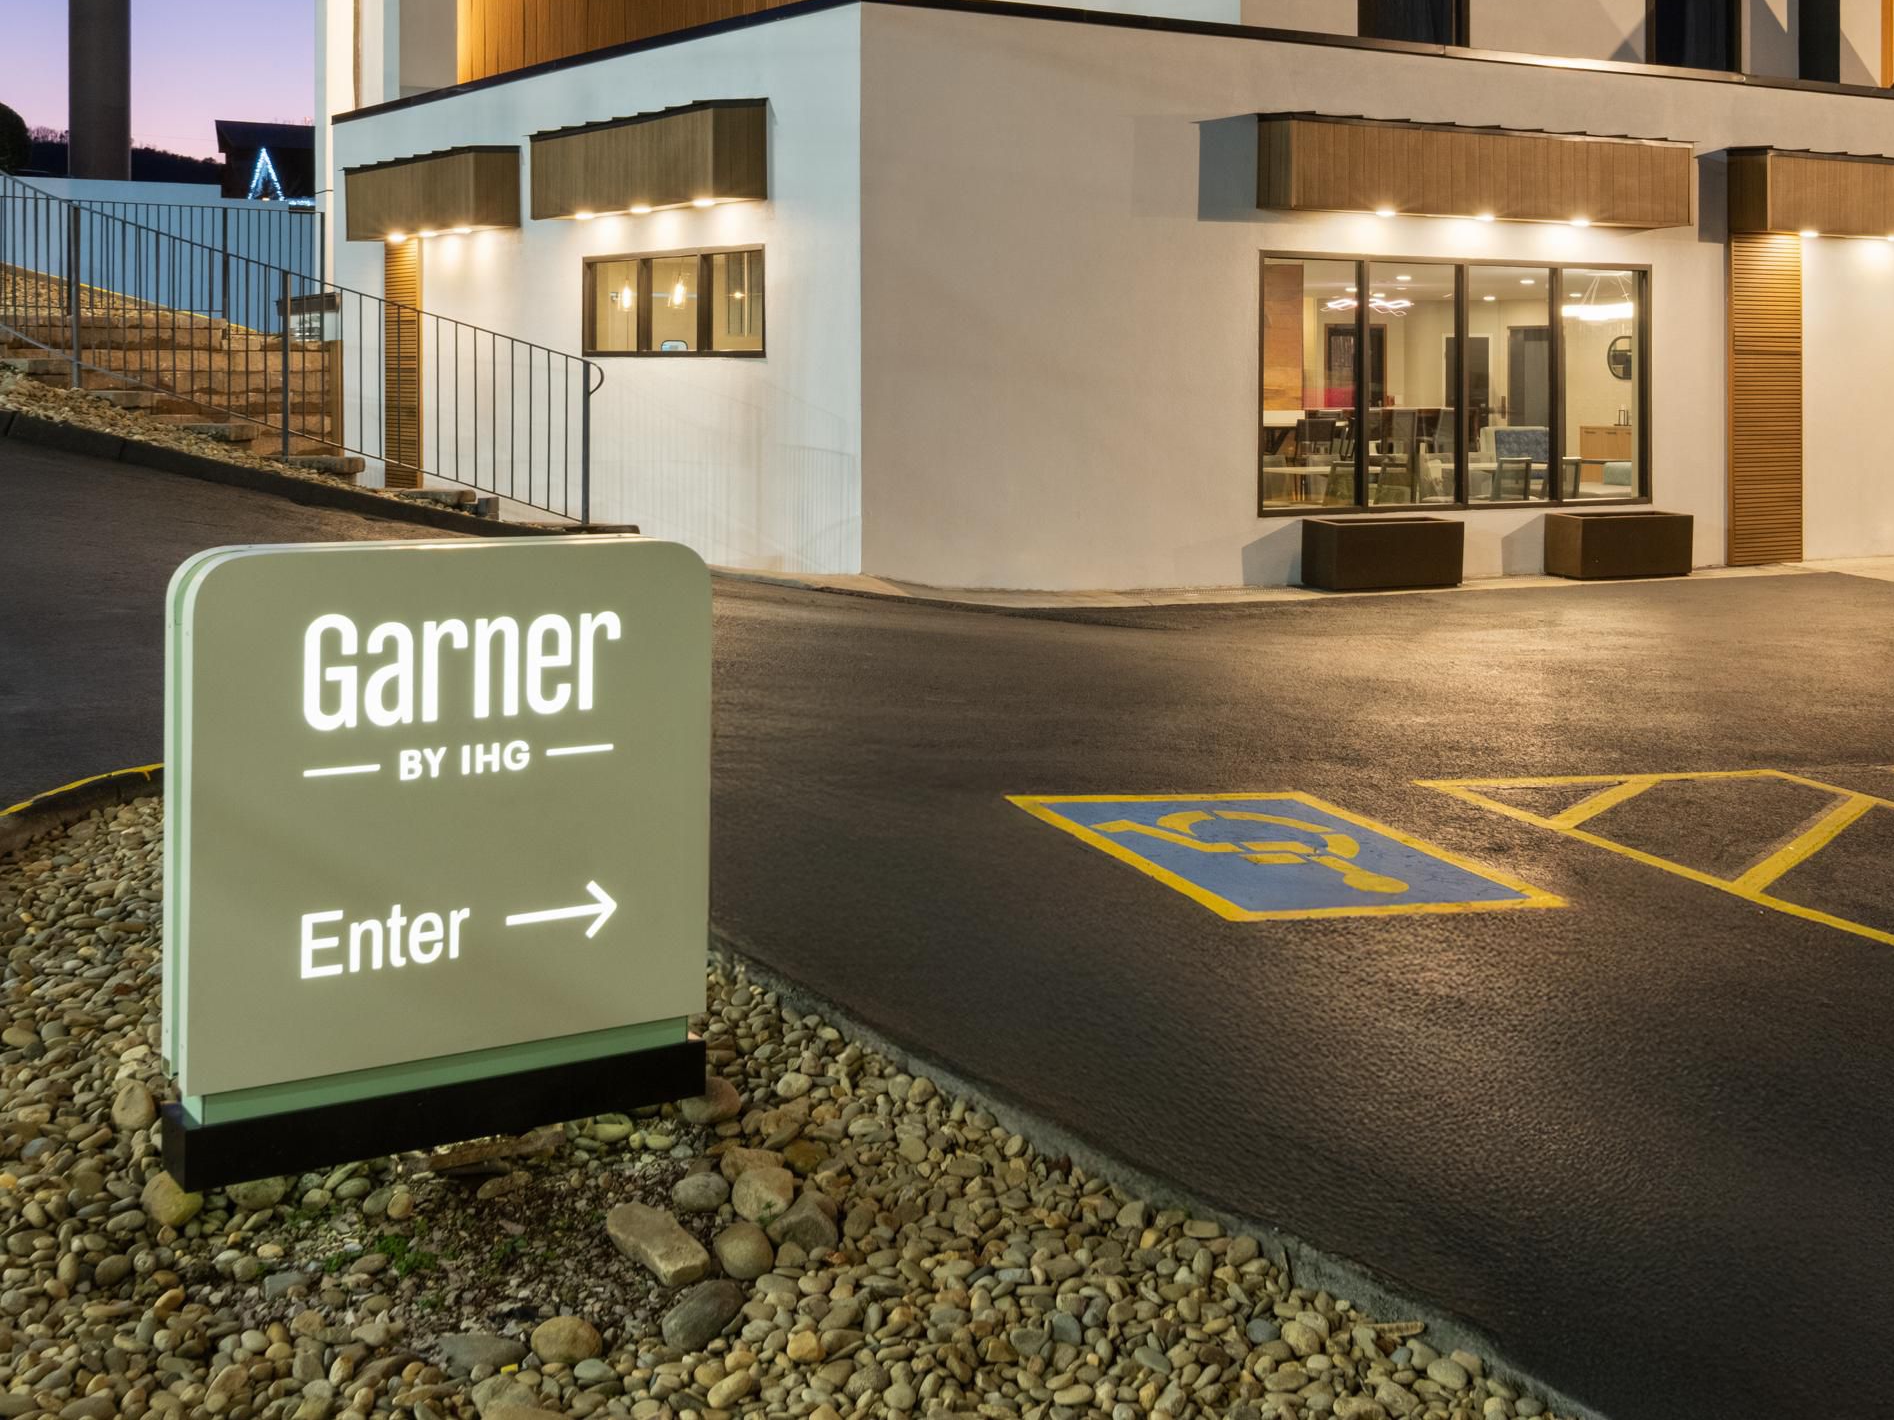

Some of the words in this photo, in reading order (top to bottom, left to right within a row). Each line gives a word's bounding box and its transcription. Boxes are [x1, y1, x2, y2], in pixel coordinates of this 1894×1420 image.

[302, 610, 622, 732] Garner
[399, 746, 448, 781] BY
[460, 740, 531, 775] IHG
[300, 903, 470, 979] Enter
